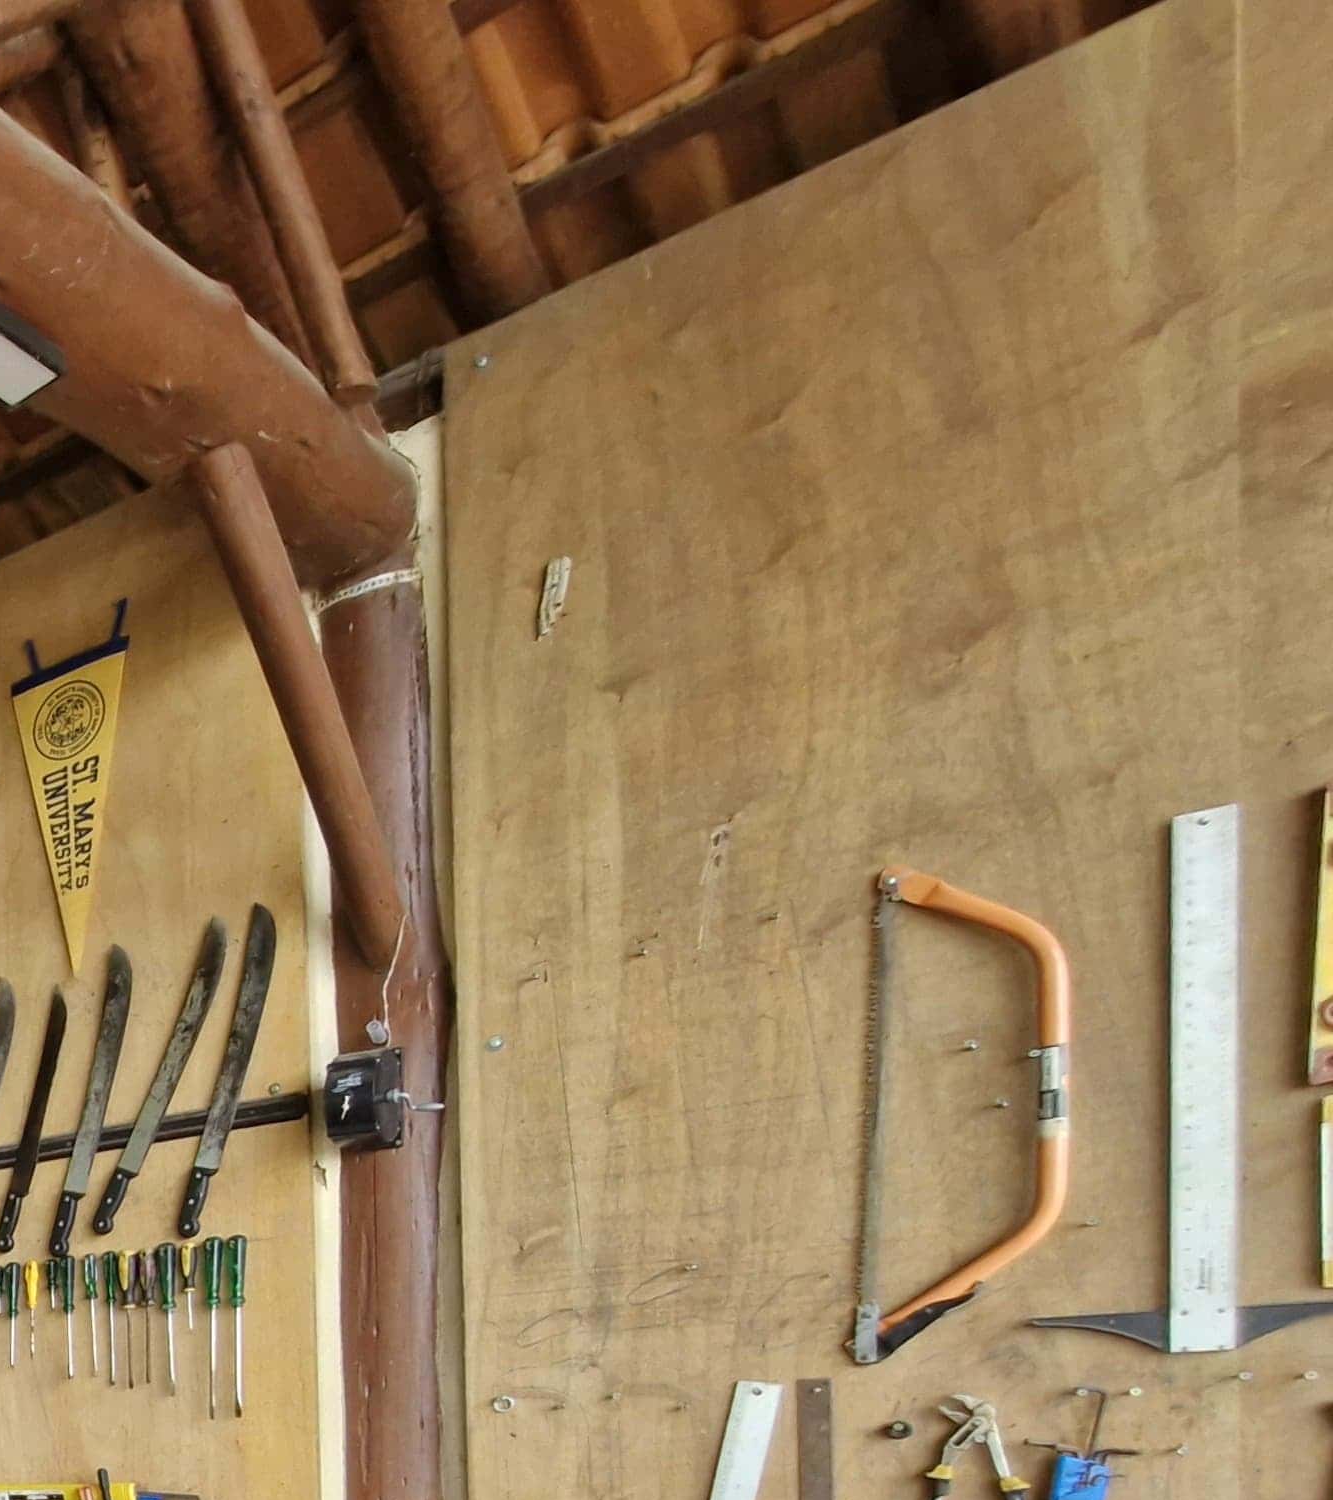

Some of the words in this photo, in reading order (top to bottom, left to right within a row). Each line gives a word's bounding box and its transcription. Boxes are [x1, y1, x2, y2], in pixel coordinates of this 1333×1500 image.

[71, 754, 100, 794] ST.
[42, 765, 73, 891] UNIVERSITY
[73, 797, 96, 890] MARY'S
